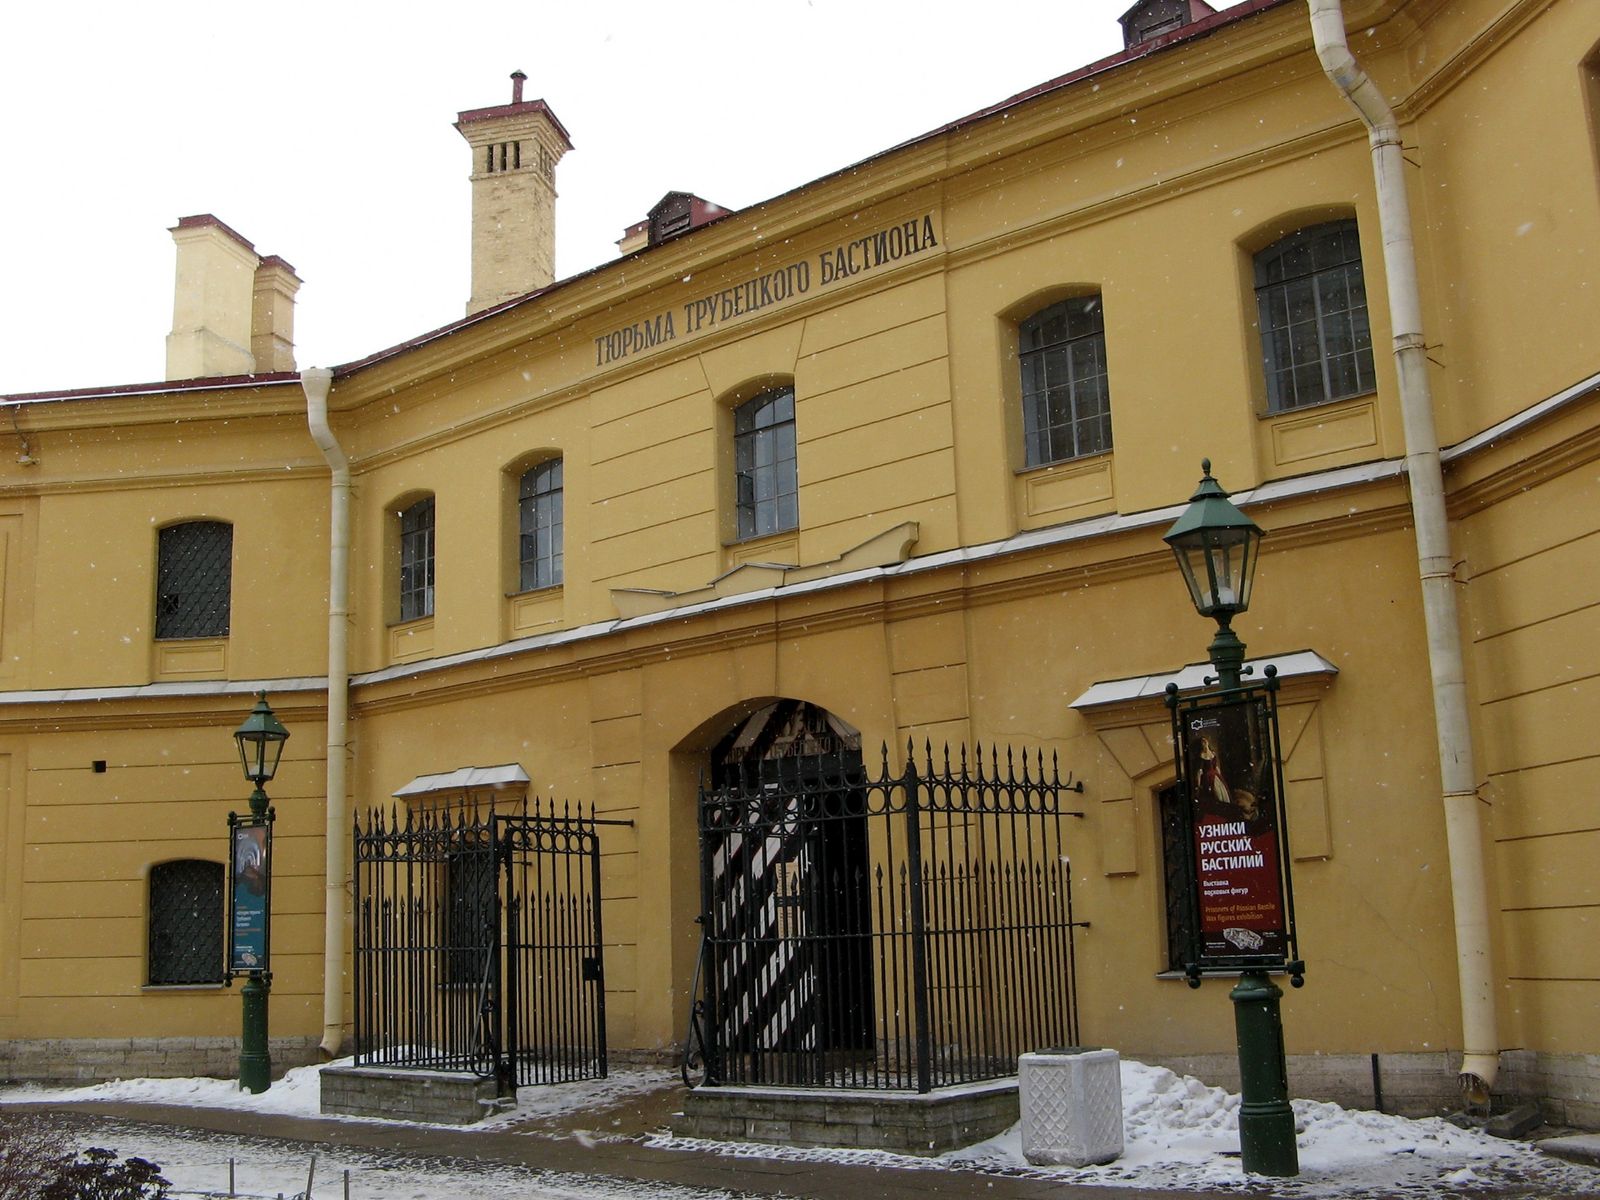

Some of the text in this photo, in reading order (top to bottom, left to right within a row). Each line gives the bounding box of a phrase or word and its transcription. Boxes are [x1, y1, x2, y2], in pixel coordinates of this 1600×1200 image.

[594, 214, 938, 367] ТЮРЬМА ТРУБЕЦКОГО БАСТИОНА
[1199, 822, 1246, 838] УЗНИКИ
[1201, 838, 1252, 854] РУССКИХ
[1202, 851, 1263, 871] БАСТИЛИЙ
[1231, 887, 1248, 896] фигур
[1229, 904, 1236, 912] of
